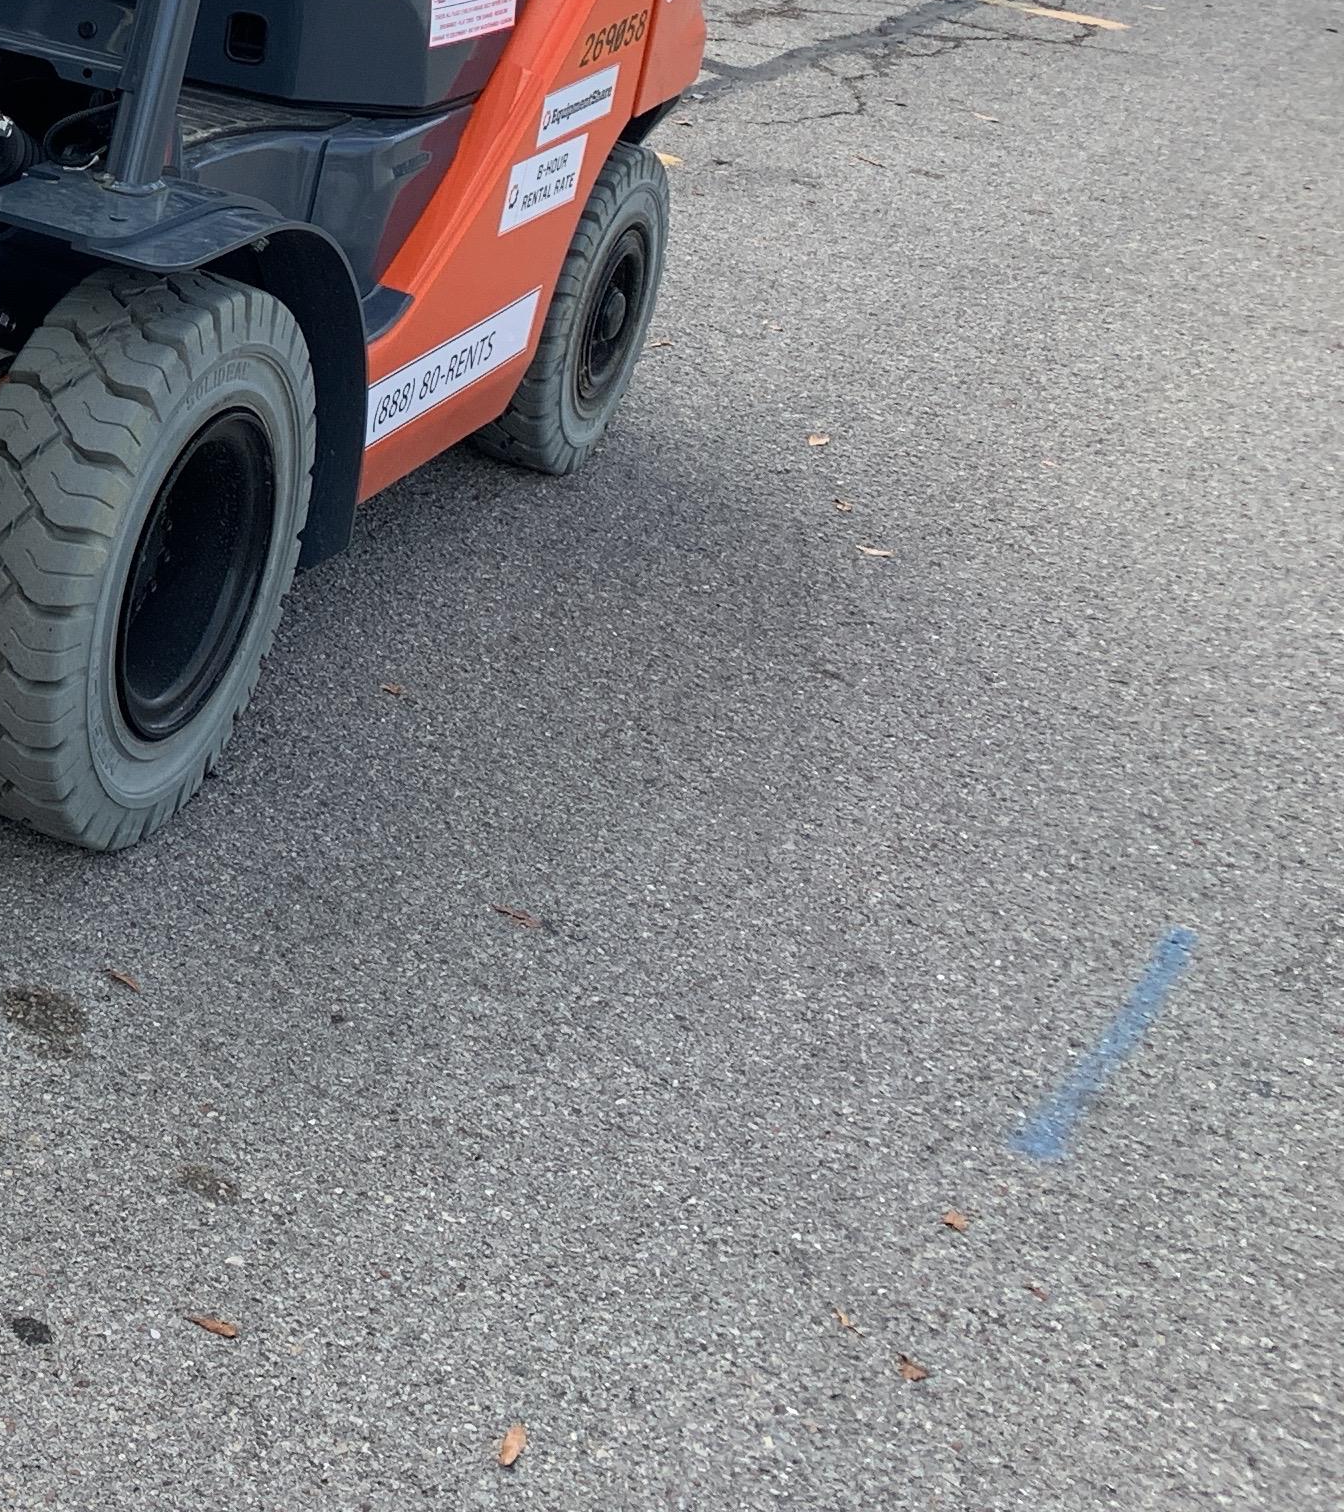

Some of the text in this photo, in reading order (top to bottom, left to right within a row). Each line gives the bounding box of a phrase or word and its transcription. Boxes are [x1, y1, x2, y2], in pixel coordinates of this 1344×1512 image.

[579, 9, 648, 68] 269058
[551, 86, 613, 125] EquipmentShare
[521, 172, 576, 211] RENTAL RATE
[372, 330, 497, 433] (888) 80-RENTS
